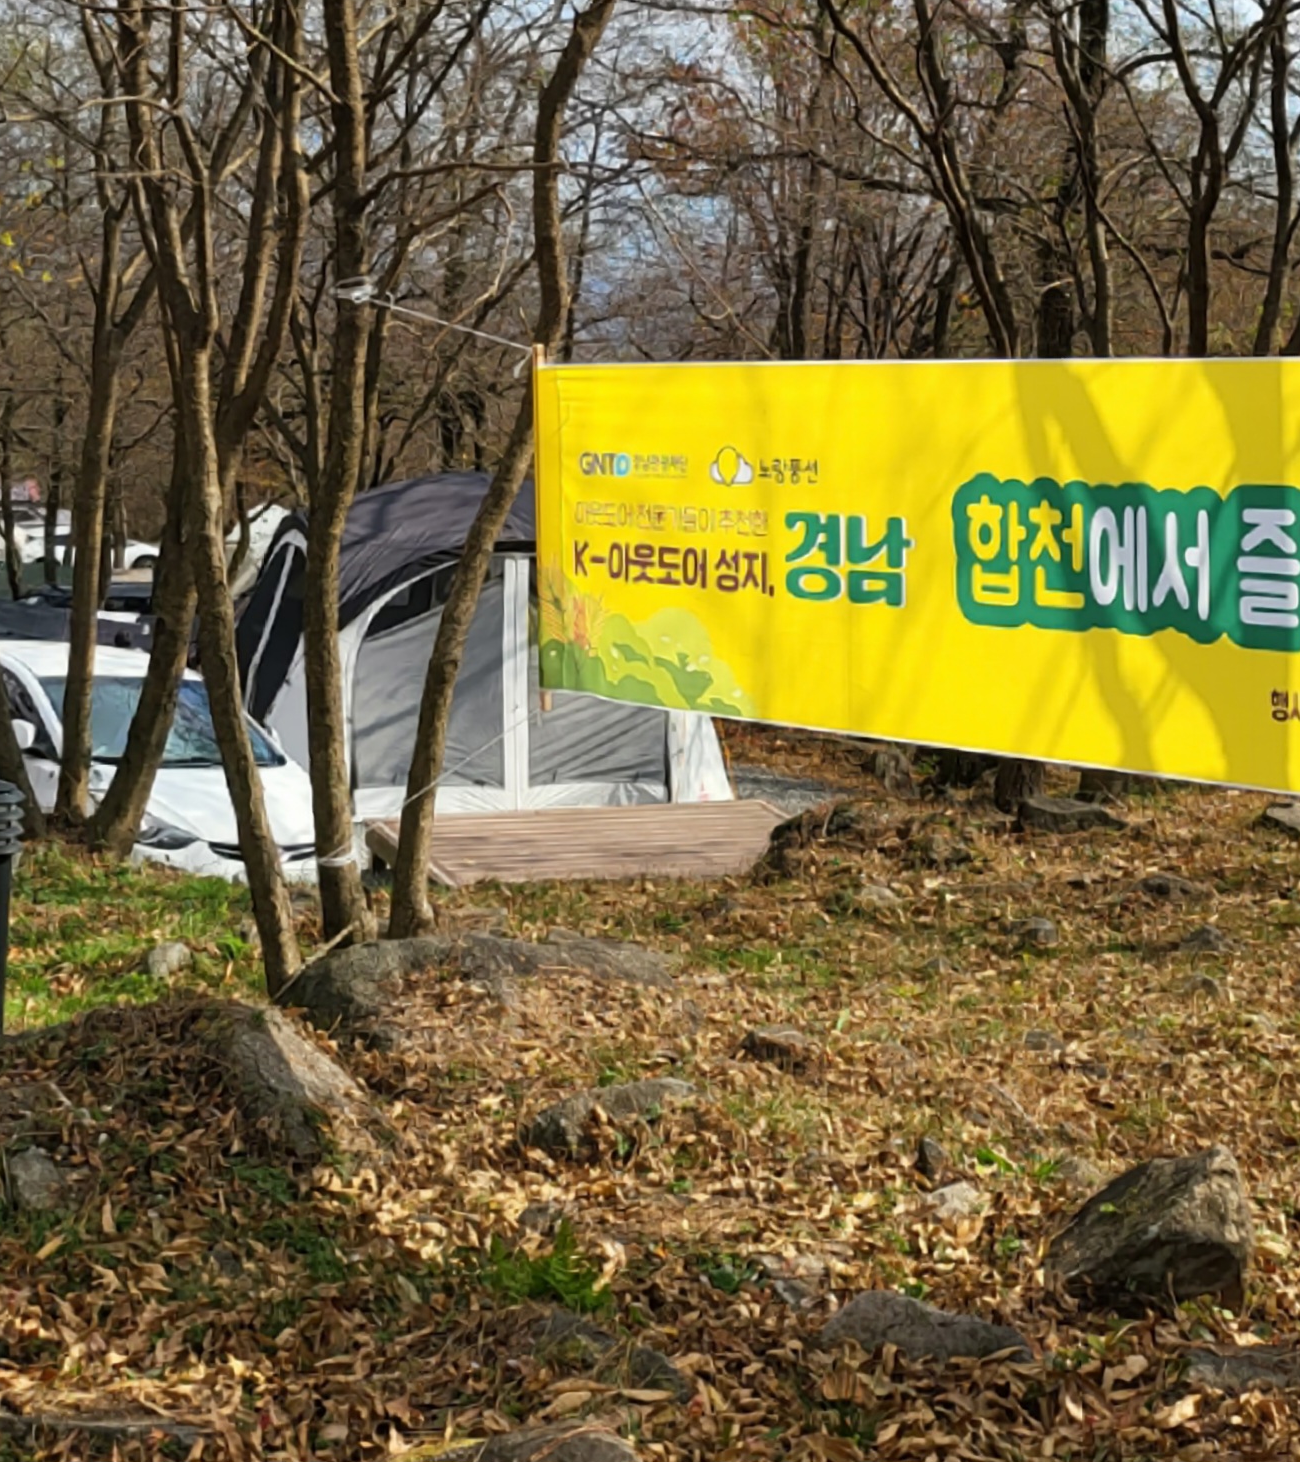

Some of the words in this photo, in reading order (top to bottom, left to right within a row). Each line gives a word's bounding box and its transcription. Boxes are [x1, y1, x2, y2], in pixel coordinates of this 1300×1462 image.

[758, 458, 819, 485] 노랑풍선
[575, 501, 634, 527] 아웃도어
[574, 540, 708, 589] K-아웃도어
[714, 548, 775, 598] 성지,
[784, 512, 915, 608] 경남
[966, 493, 1210, 622] 합천에서
